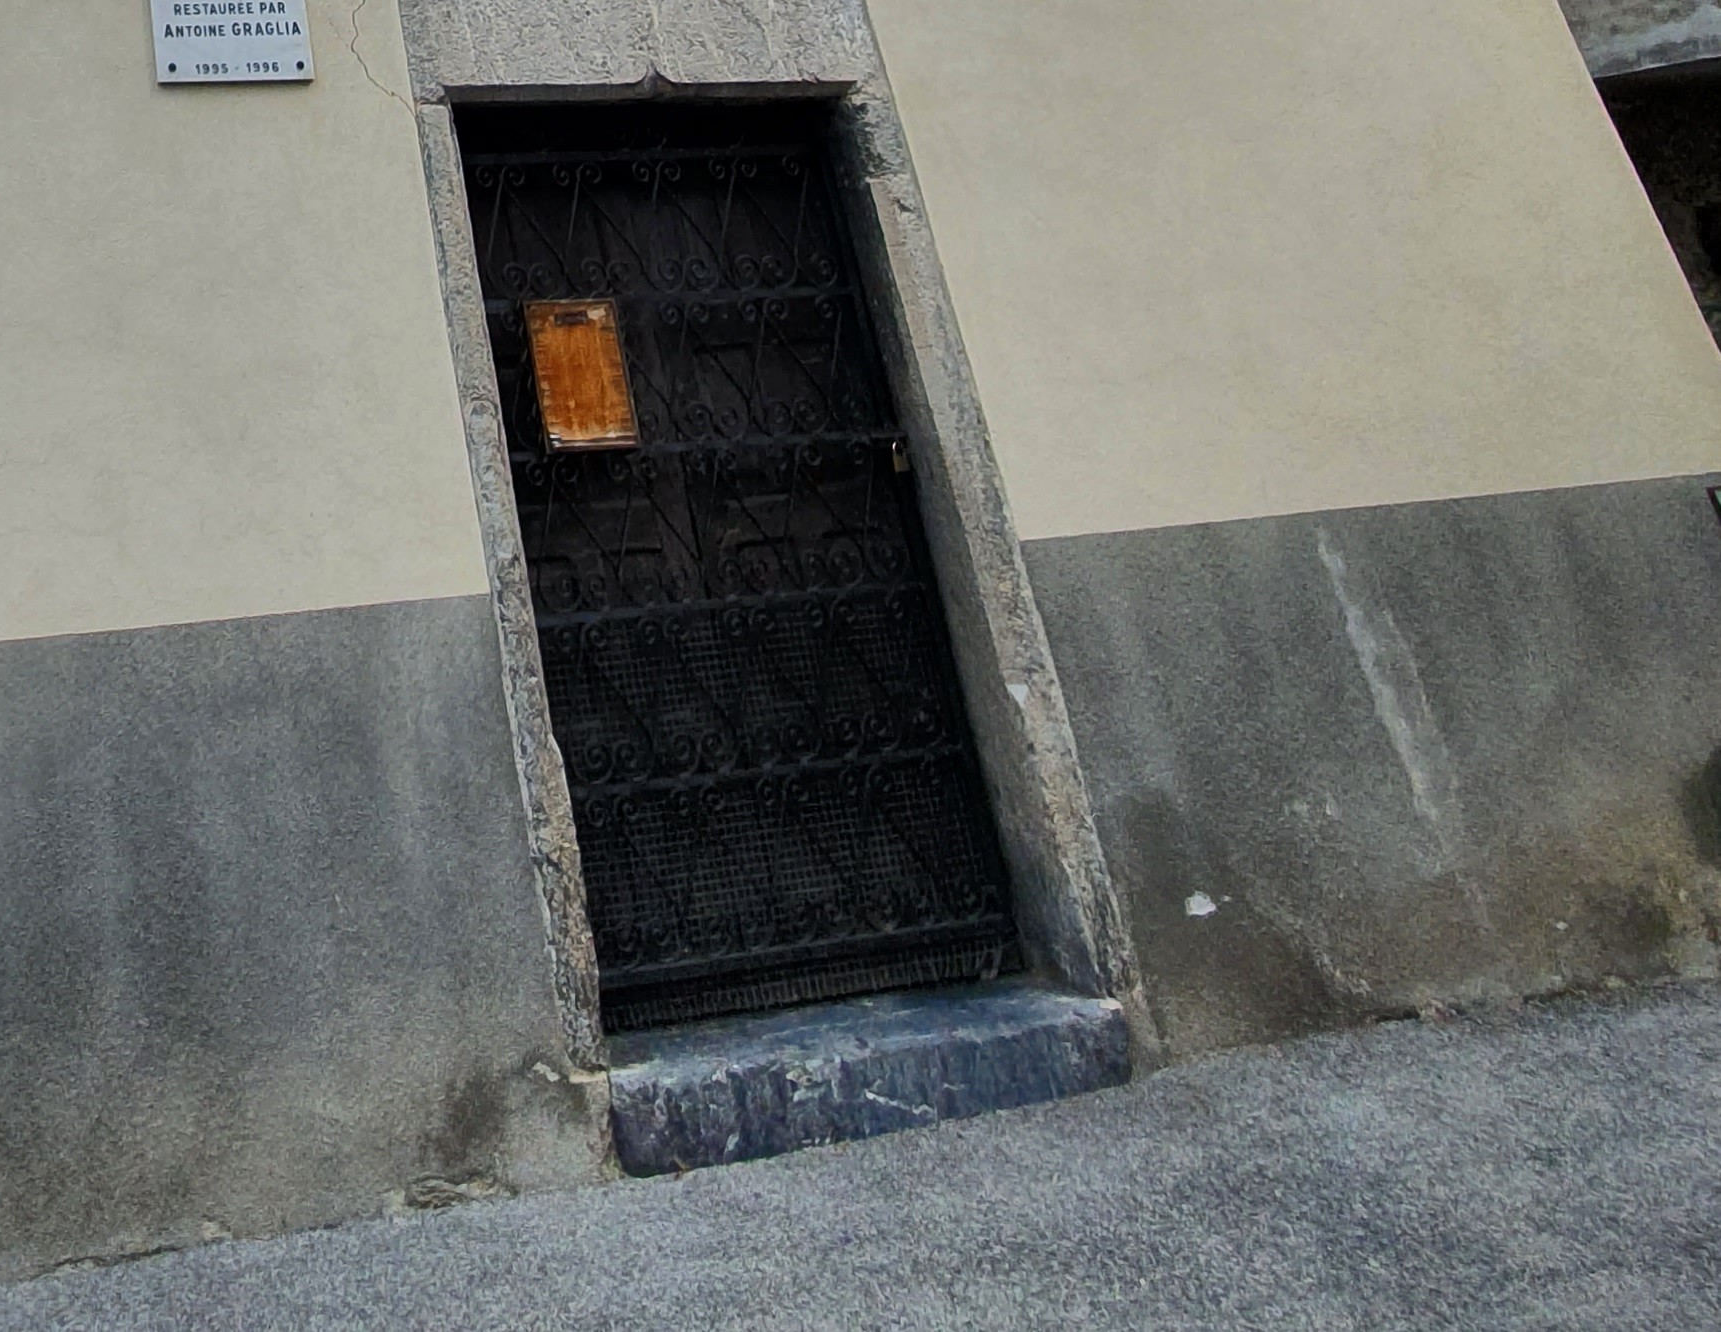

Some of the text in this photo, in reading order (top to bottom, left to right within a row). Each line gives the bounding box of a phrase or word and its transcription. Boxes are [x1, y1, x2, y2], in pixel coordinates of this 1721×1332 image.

[259, 1, 286, 15] PAR
[164, 21, 302, 38] ANTOINE GRAGLIA
[195, 63, 229, 75] 1995
[246, 61, 279, 74] 1996
